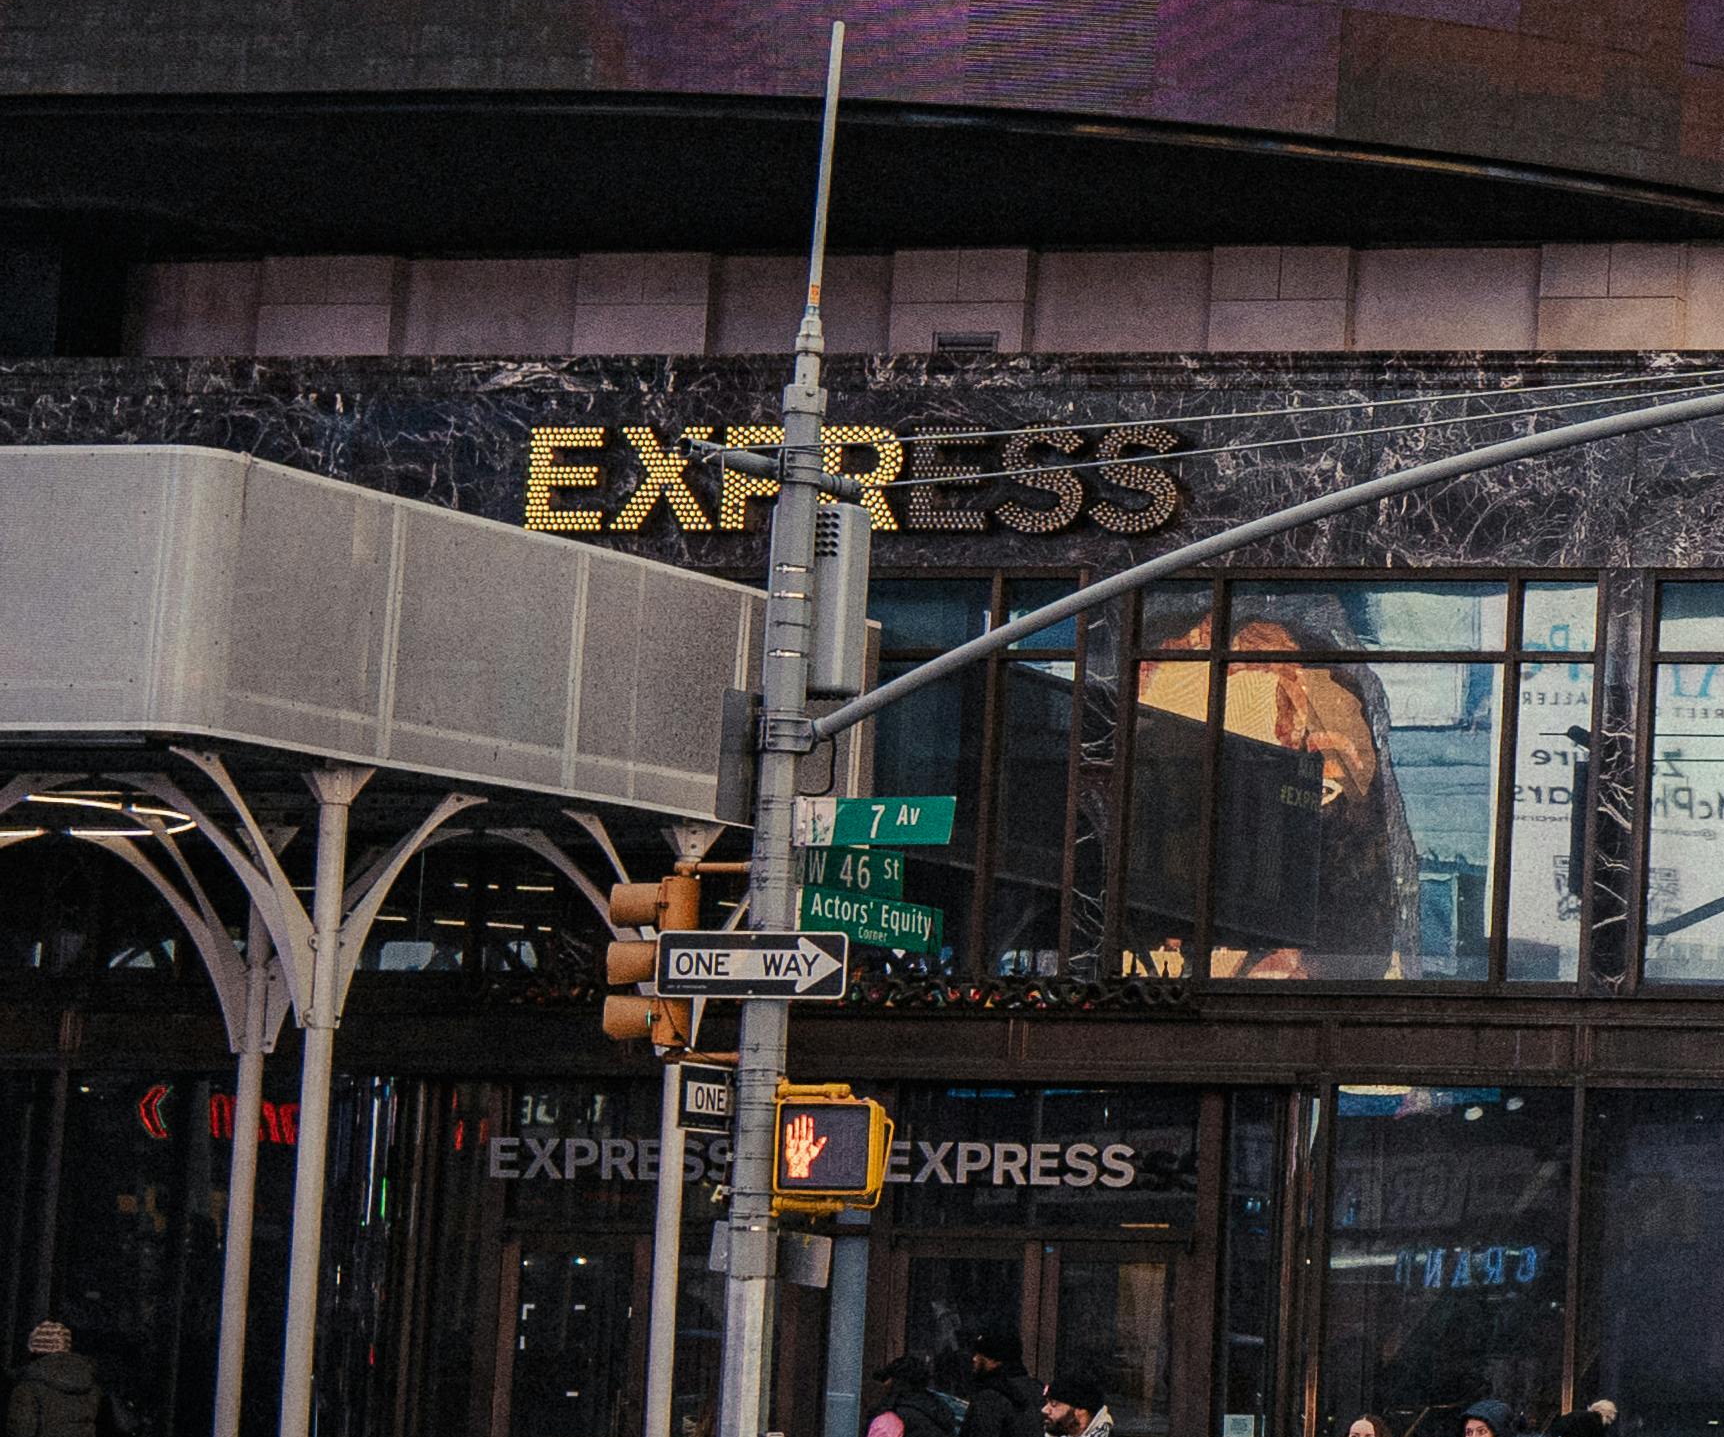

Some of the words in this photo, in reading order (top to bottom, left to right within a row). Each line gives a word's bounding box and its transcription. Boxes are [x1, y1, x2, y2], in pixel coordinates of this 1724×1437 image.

[523, 423, 1189, 536] EXPRESS
[869, 804, 886, 839] 7
[896, 804, 921, 827] Av
[807, 850, 826, 885] W
[839, 853, 871, 891] 46
[883, 857, 900, 881] St
[857, 926, 888, 944] Corner
[881, 904, 932, 941] Equity
[674, 951, 731, 977] ONE
[762, 952, 822, 977] WAY
[694, 1084, 726, 1113] ONE
[886, 1139, 1136, 1189] EXPRESS
